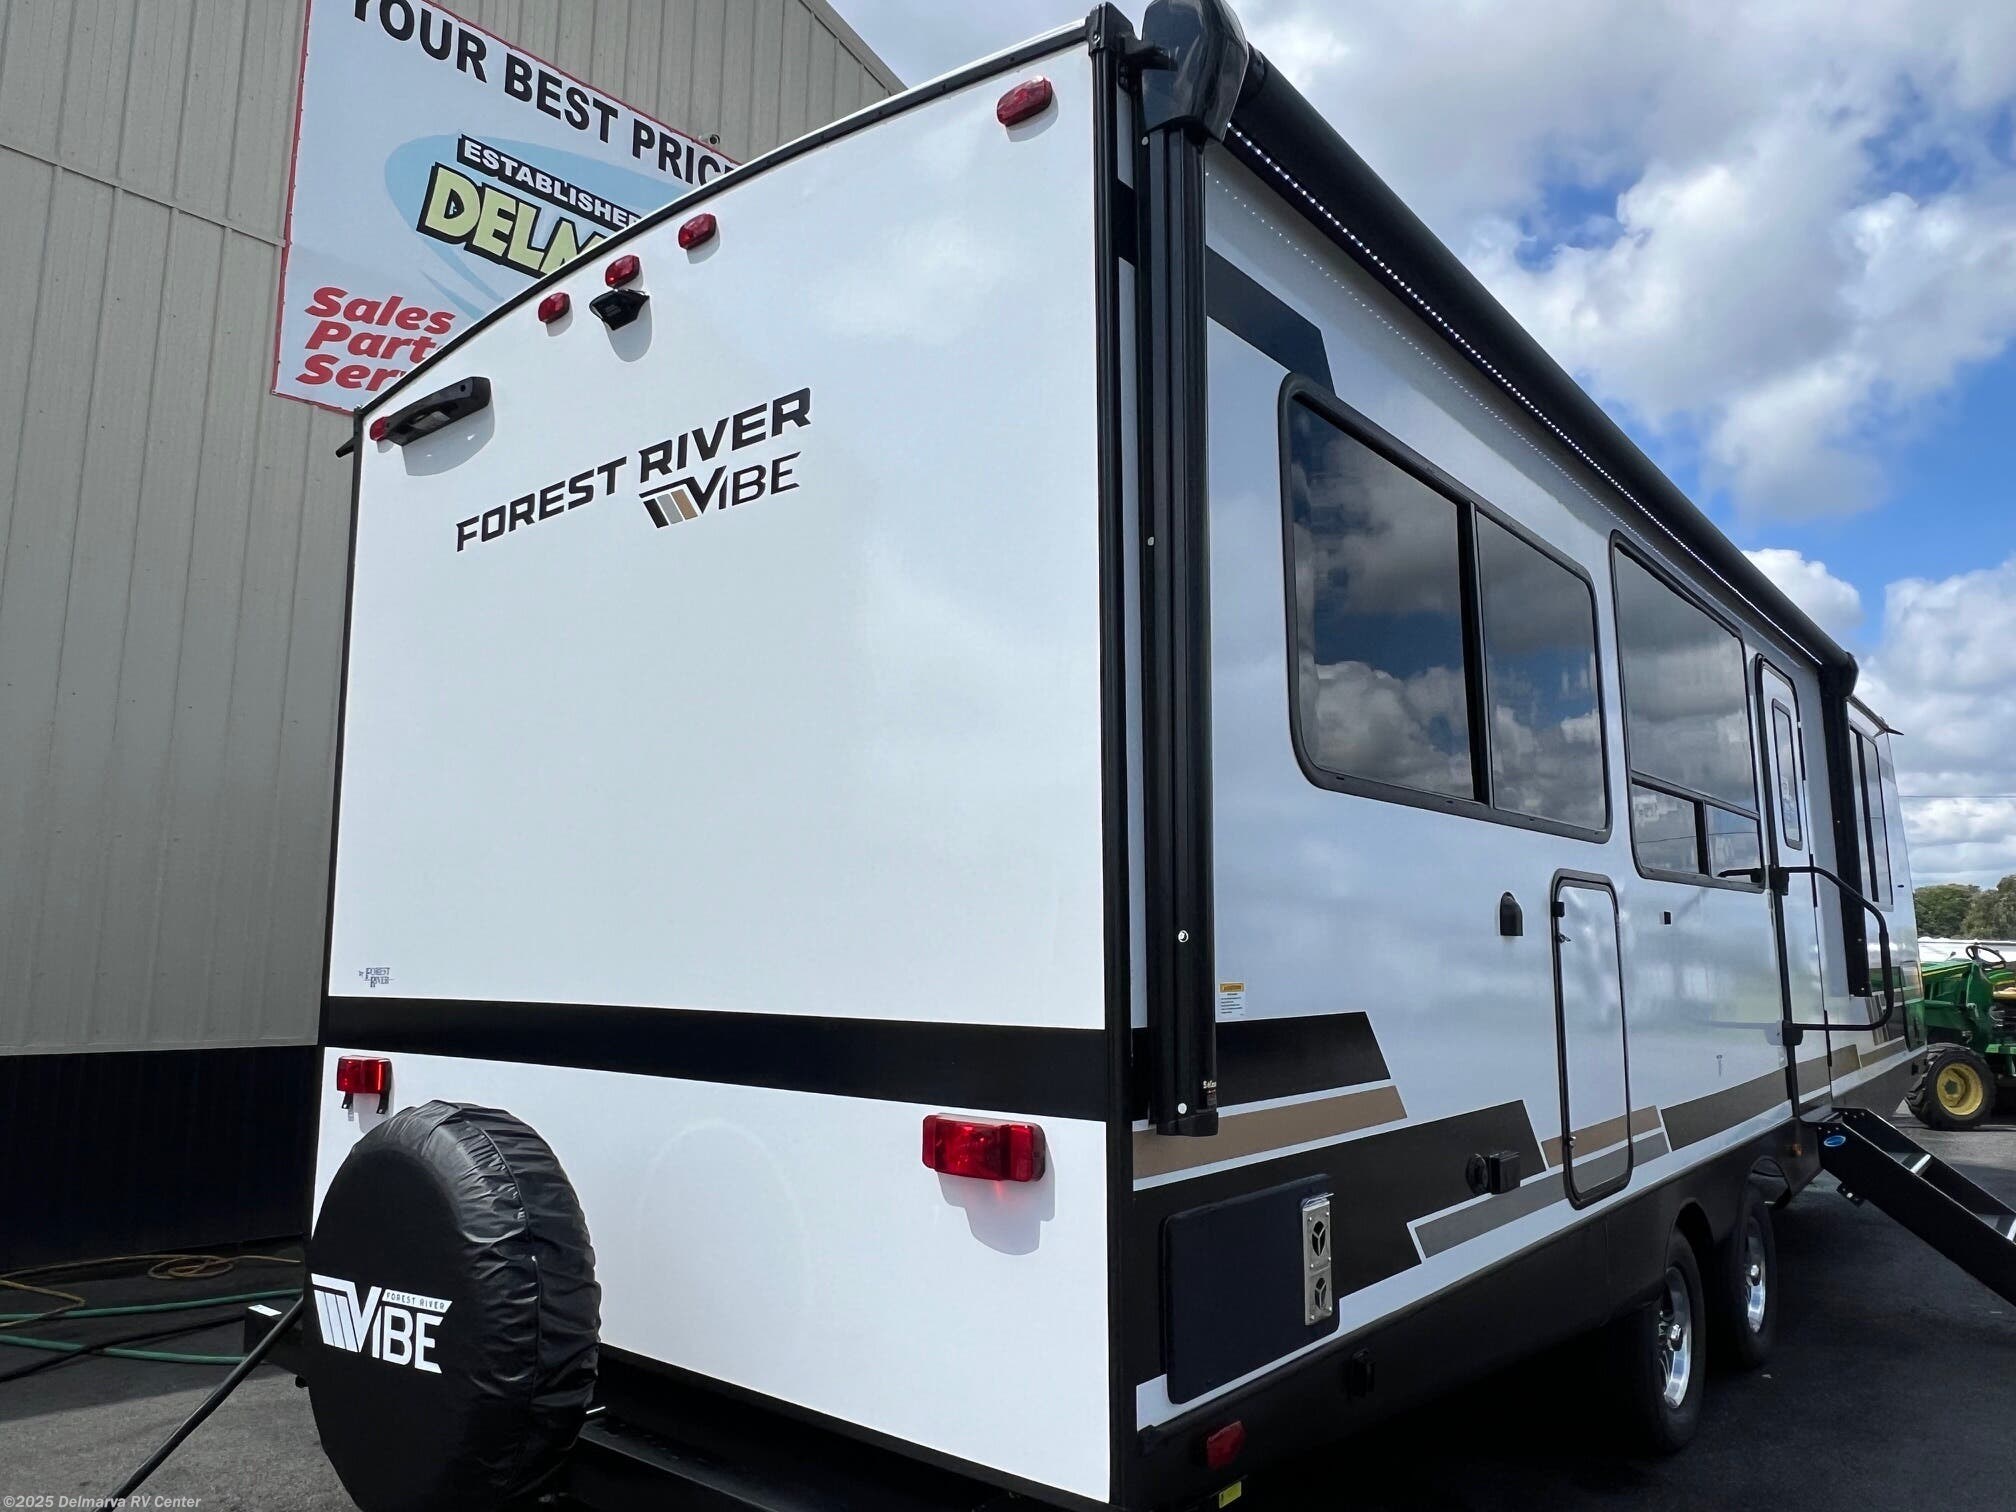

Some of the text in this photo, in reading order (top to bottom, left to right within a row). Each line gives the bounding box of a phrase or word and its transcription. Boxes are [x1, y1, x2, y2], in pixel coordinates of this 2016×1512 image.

[504, 52, 618, 144] BEST
[632, 118, 740, 187] PRIC
[421, 164, 606, 278] DELM
[304, 286, 456, 335] Sales
[305, 320, 443, 364] Part
[295, 353, 407, 392] Ser
[456, 387, 811, 552] FOREST RIVER
[638, 451, 801, 529] VIBE
[311, 1273, 444, 1374] VIBE
[387, 1292, 445, 1310] FOREST RIVER
